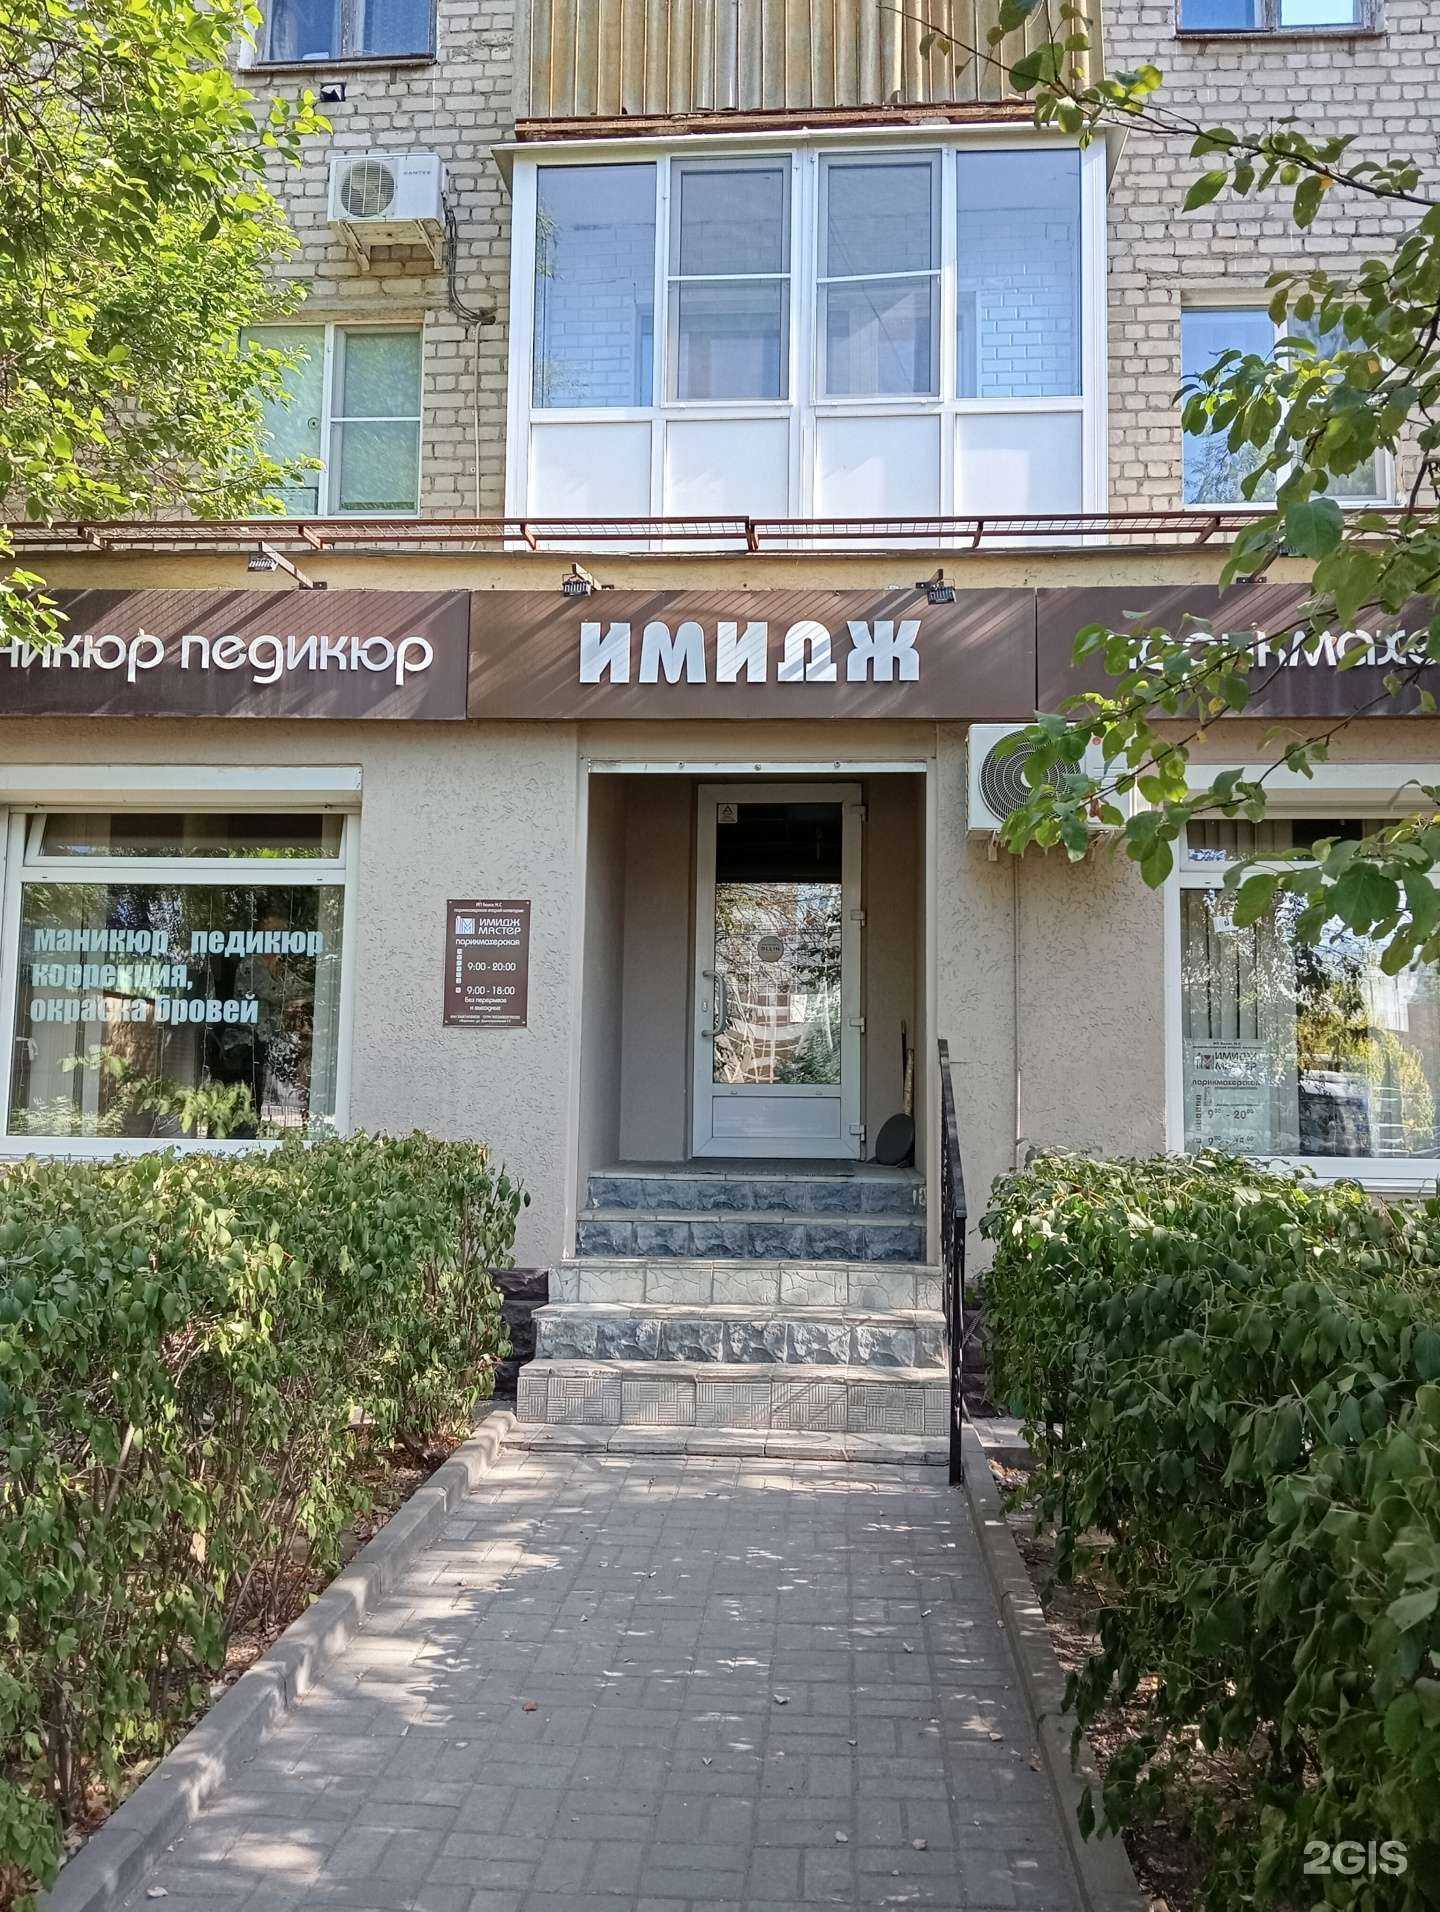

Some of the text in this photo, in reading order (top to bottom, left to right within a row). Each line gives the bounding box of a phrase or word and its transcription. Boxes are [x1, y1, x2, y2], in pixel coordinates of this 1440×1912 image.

[180, 634, 433, 686] педикюр
[579, 620, 922, 684] ИМИДЖ
[34, 928, 323, 957] маникюр педикюр
[467, 962, 486, 971] 9:00
[492, 962, 517, 971] 20:00
[466, 986, 486, 995] 9:00
[492, 986, 515, 995] 18:00
[30, 991, 258, 1025] окраска бровей
